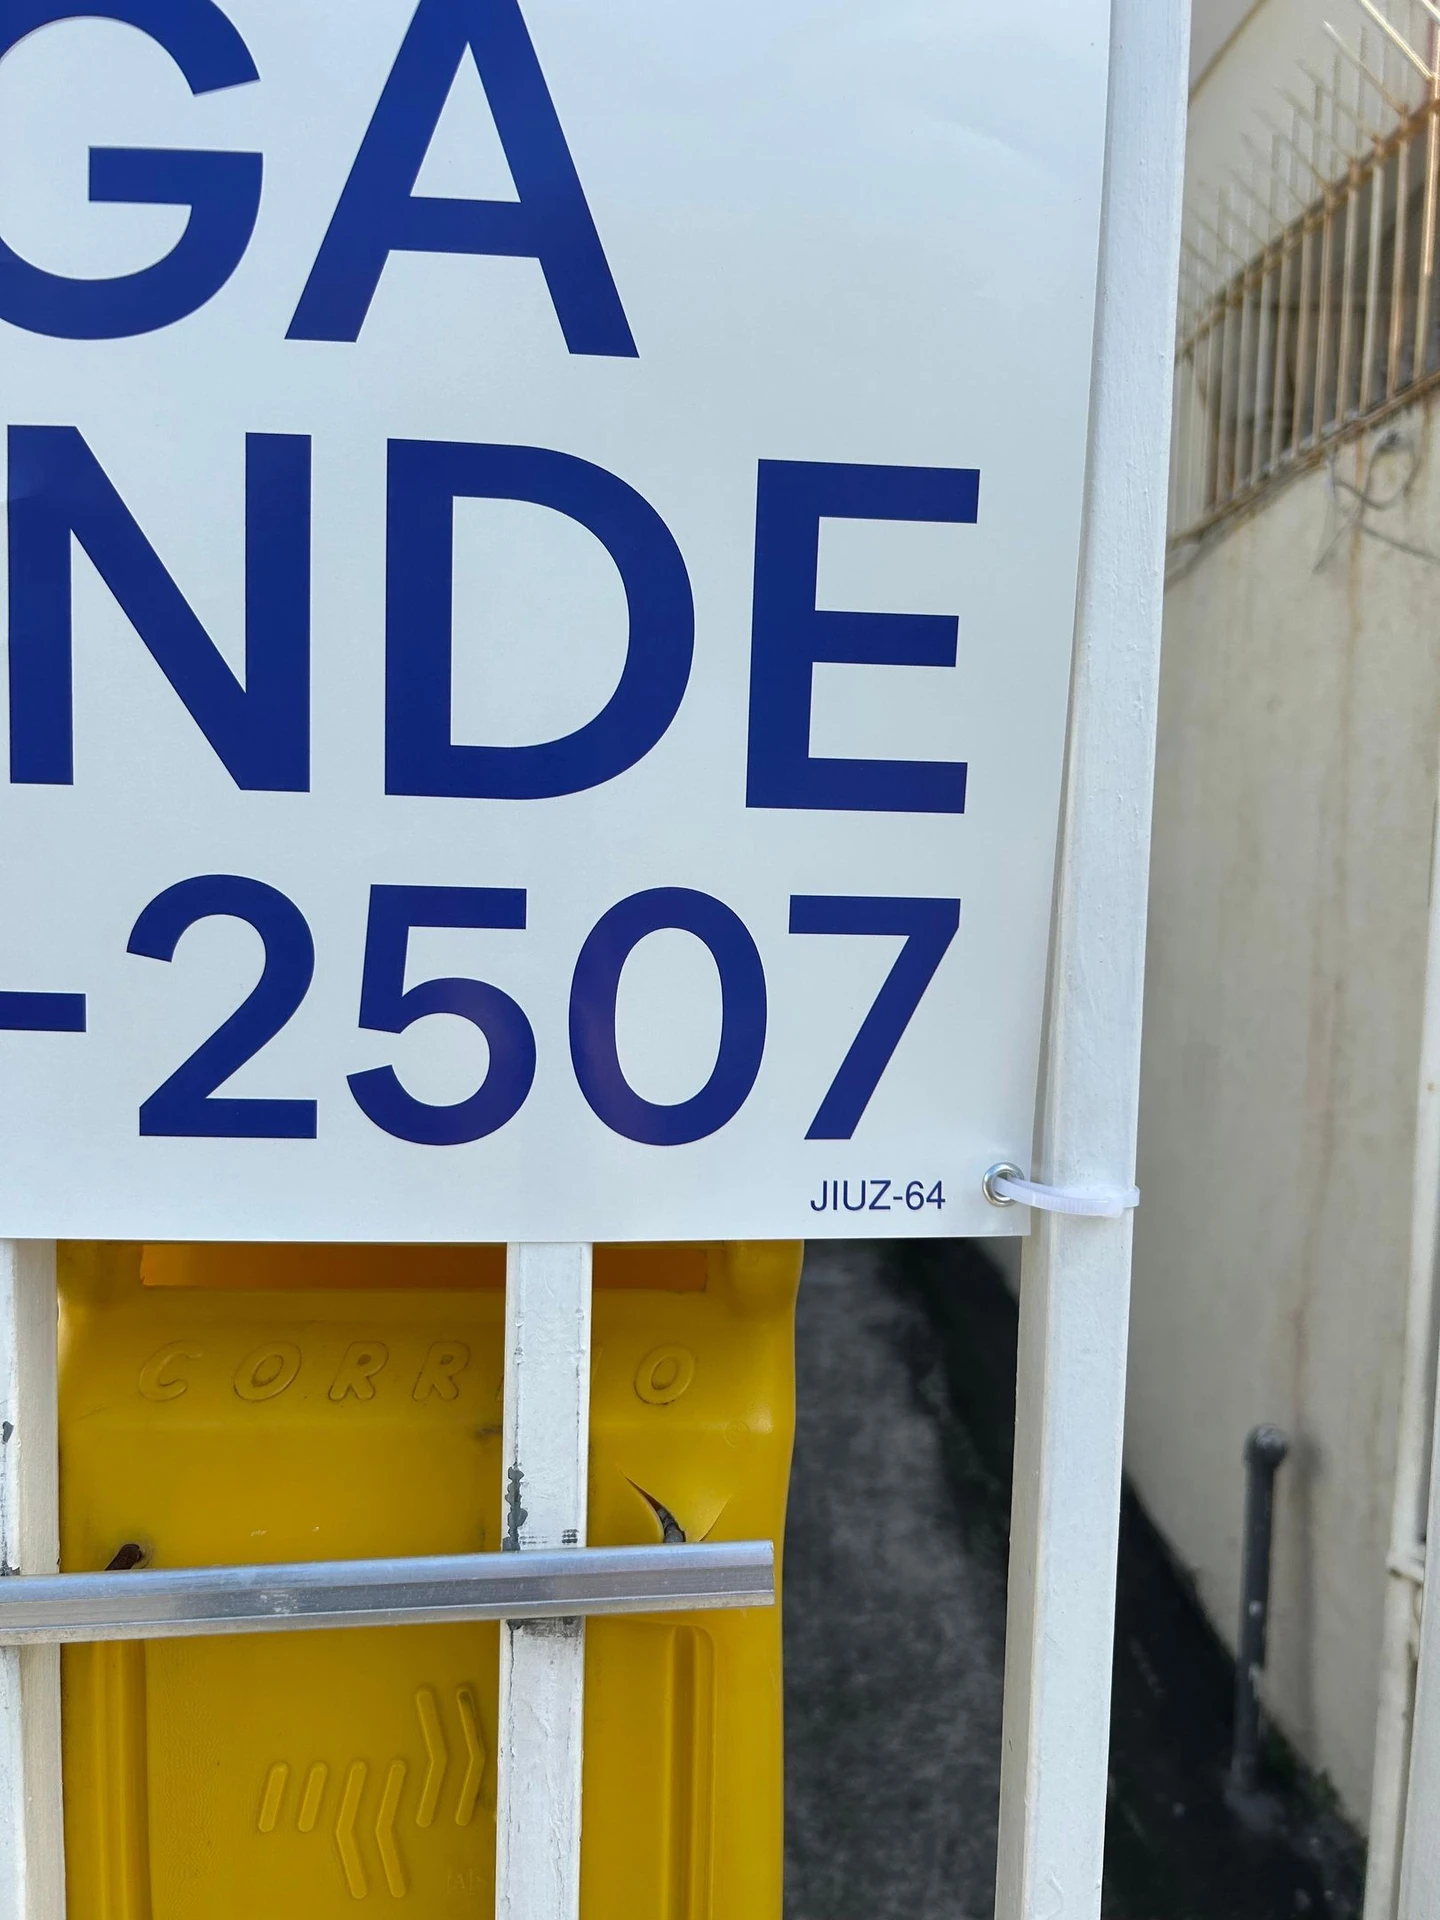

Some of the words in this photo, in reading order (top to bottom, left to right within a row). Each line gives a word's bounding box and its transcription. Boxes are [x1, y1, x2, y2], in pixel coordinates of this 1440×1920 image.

[6, 425, 981, 814] NDE
[810, 1179, 946, 1211] JIUZ-64
[137, 1339, 698, 1406] CORRO
